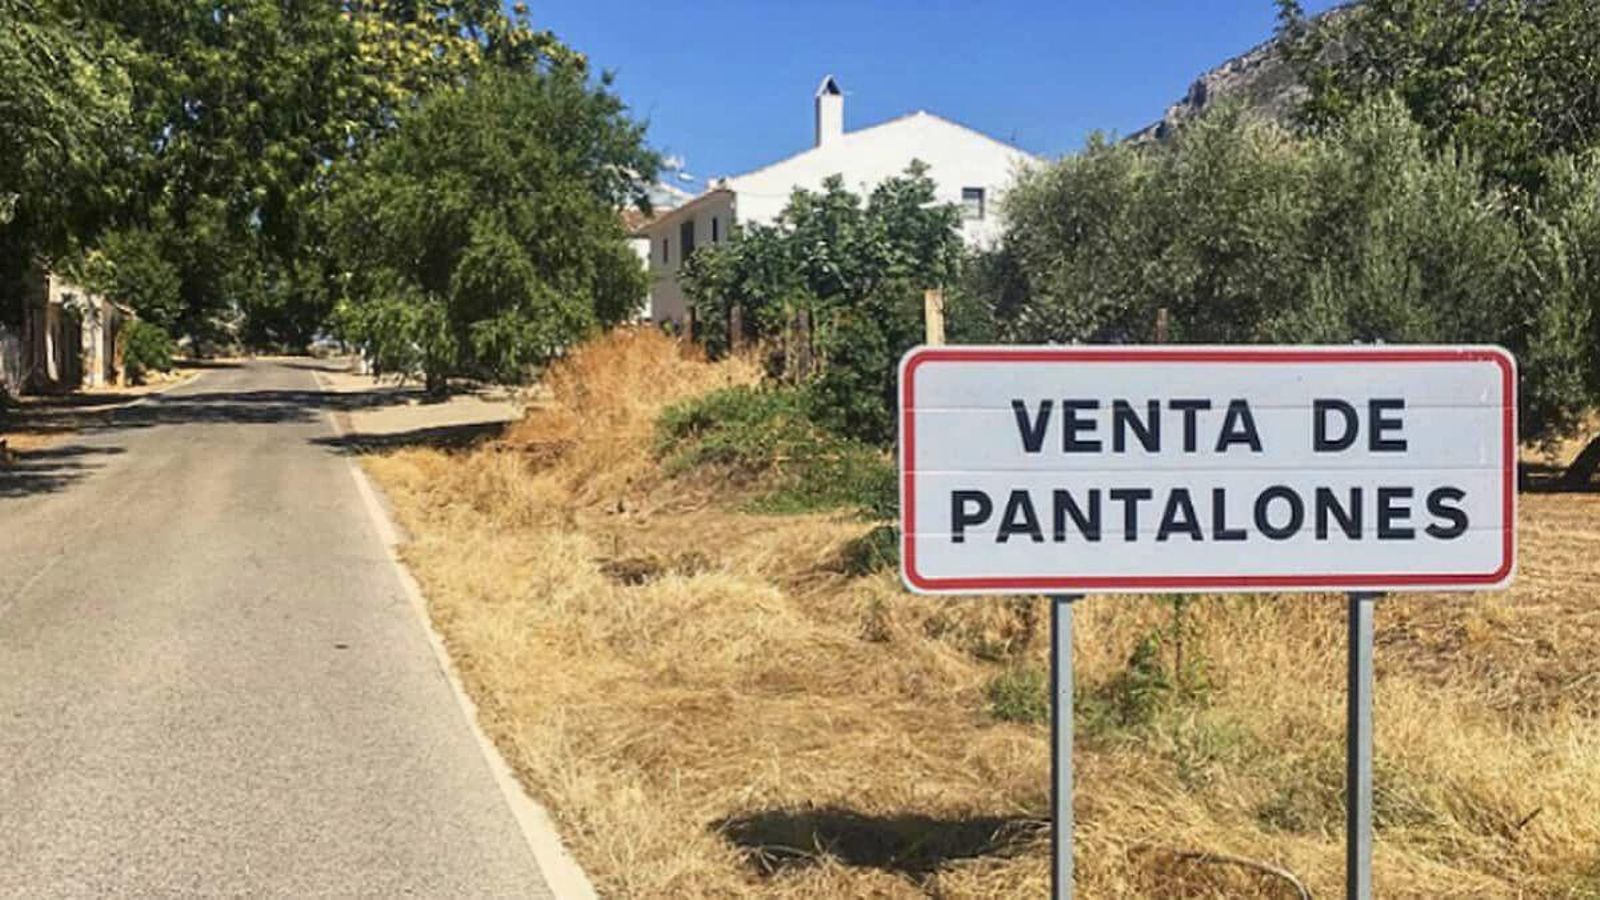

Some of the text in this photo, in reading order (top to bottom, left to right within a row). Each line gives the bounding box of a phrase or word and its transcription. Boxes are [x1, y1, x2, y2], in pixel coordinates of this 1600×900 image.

[1011, 398, 1408, 453] VENTA DE
[951, 486, 1469, 543] PANTALONES
